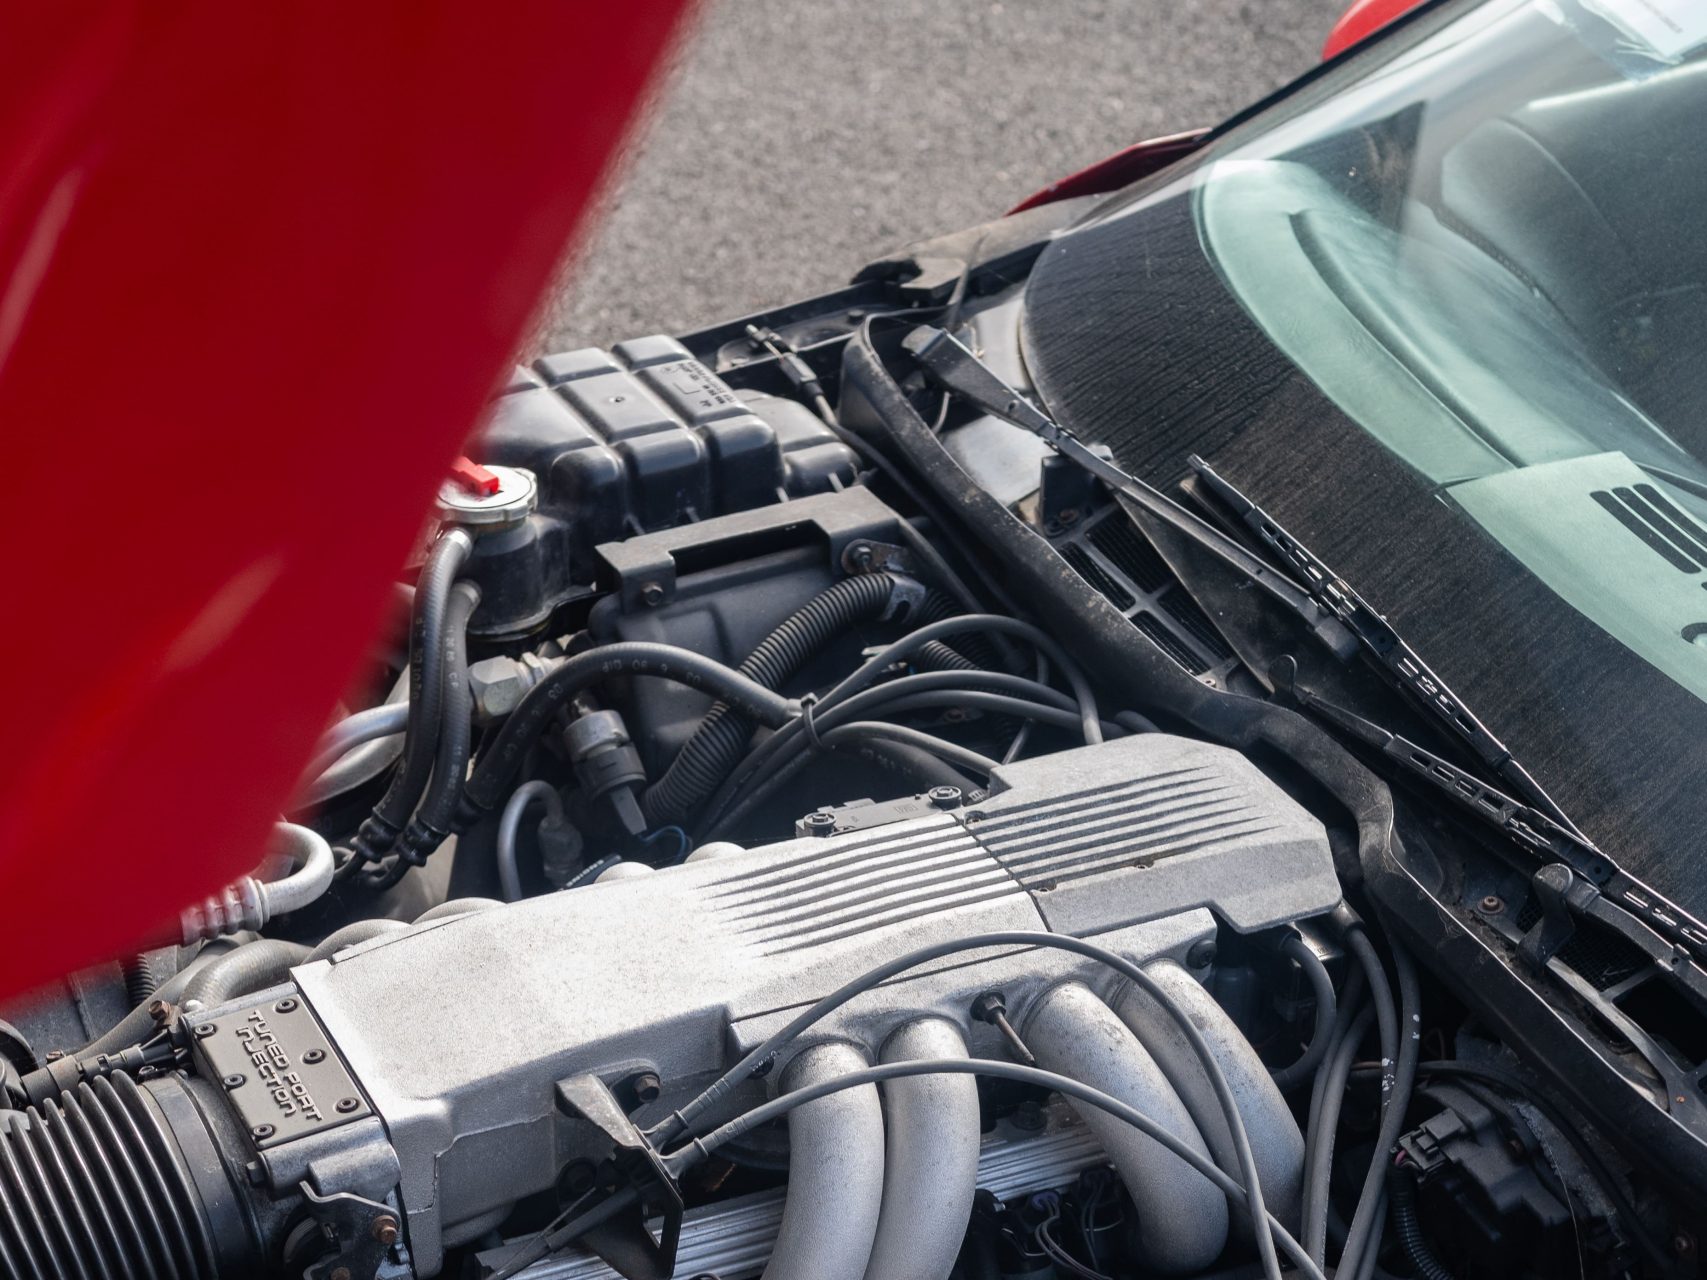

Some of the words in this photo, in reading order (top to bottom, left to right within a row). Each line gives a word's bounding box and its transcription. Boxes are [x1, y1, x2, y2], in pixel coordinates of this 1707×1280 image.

[236, 1026, 297, 1118] INJECTION
[248, 1009, 290, 1070] TUNED
[283, 1071, 324, 1121] PORT
